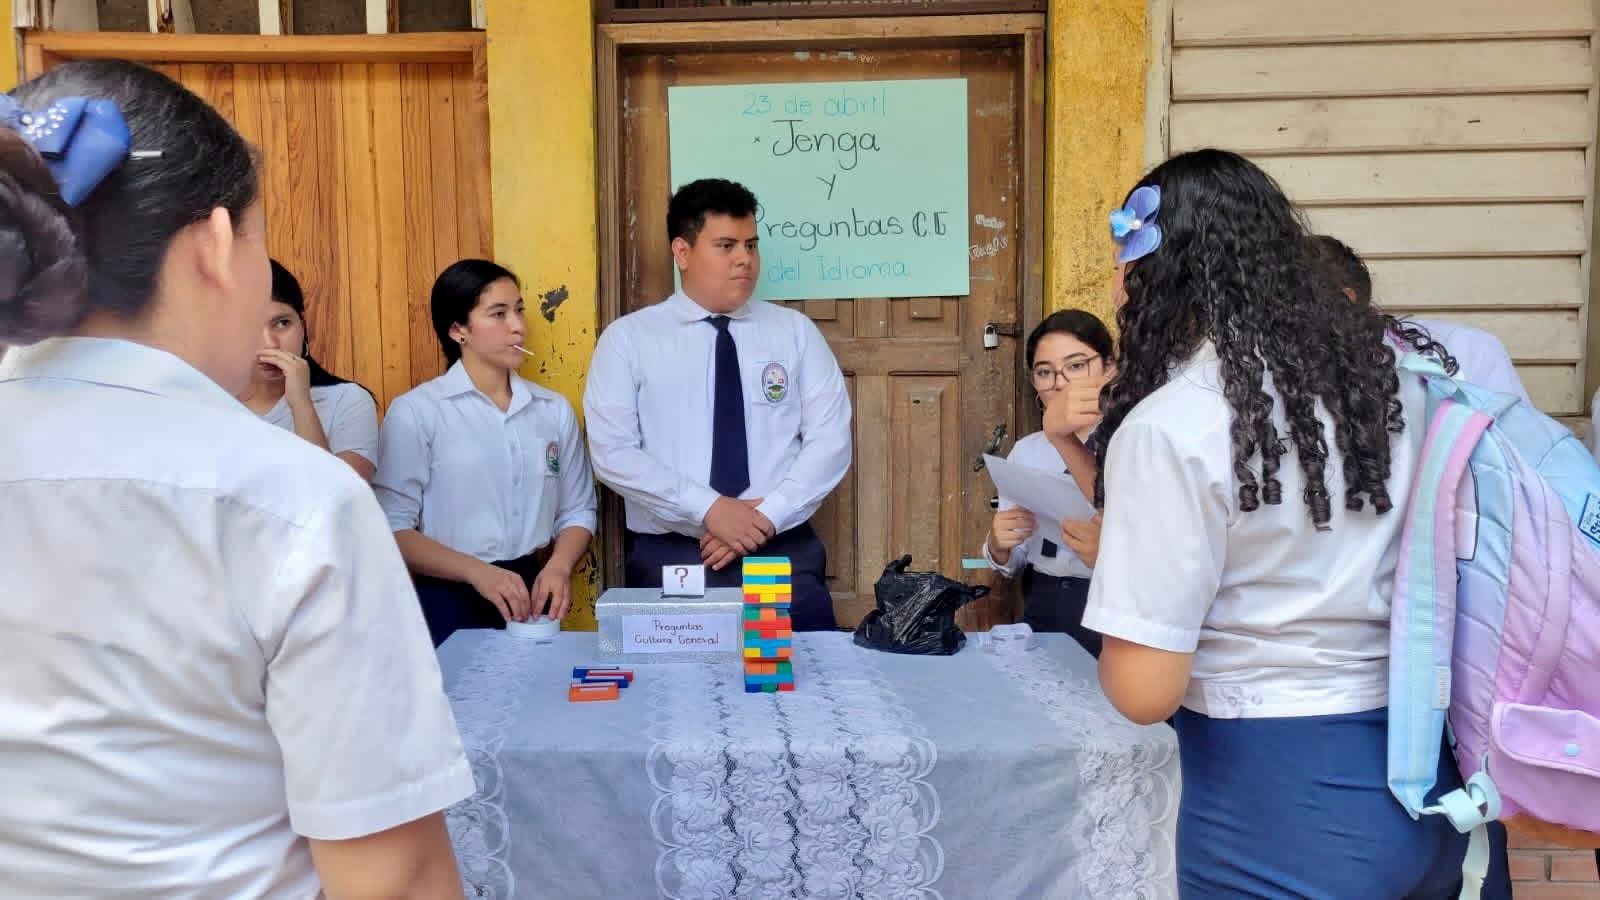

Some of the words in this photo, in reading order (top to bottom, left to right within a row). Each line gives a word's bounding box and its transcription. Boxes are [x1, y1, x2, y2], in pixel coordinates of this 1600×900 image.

[741, 91, 772, 116] 23
[785, 95, 812, 114] de
[823, 88, 887, 117] abril
[772, 119, 881, 171] Jenga
[767, 256, 801, 281] del
[815, 255, 912, 281] Idioma
[674, 567, 689, 589] ?
[634, 634, 672, 645] Cultura
[678, 632, 720, 645] General
[652, 619, 704, 636] Preguntas
